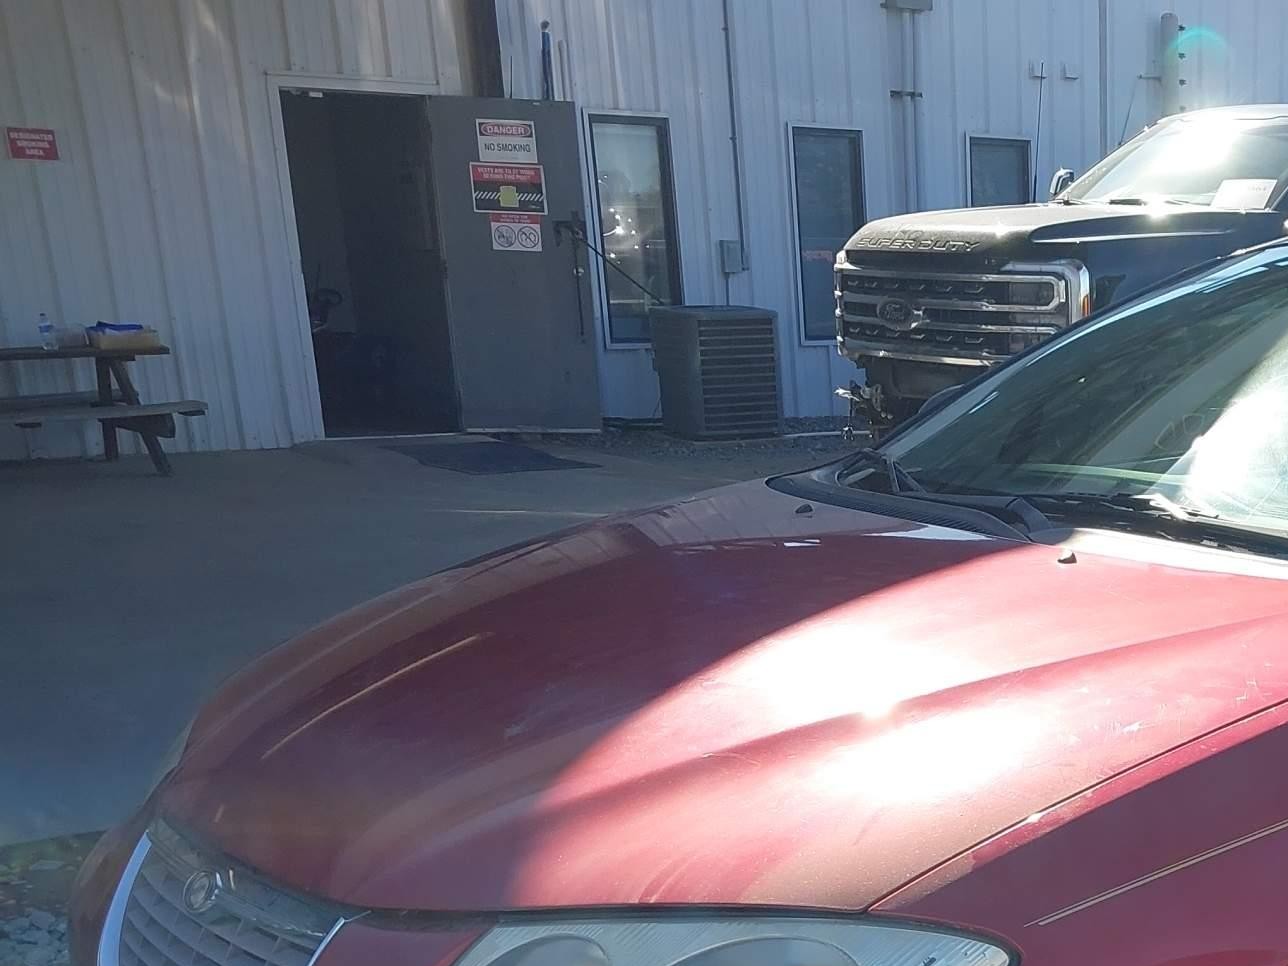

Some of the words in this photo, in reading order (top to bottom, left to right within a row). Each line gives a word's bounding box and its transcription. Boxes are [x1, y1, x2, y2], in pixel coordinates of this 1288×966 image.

[486, 125, 525, 135] DANGER
[484, 142, 495, 151] NO
[496, 143, 531, 152] SMOKING
[857, 239, 915, 249] SUPER
[918, 241, 980, 252] DUTY
